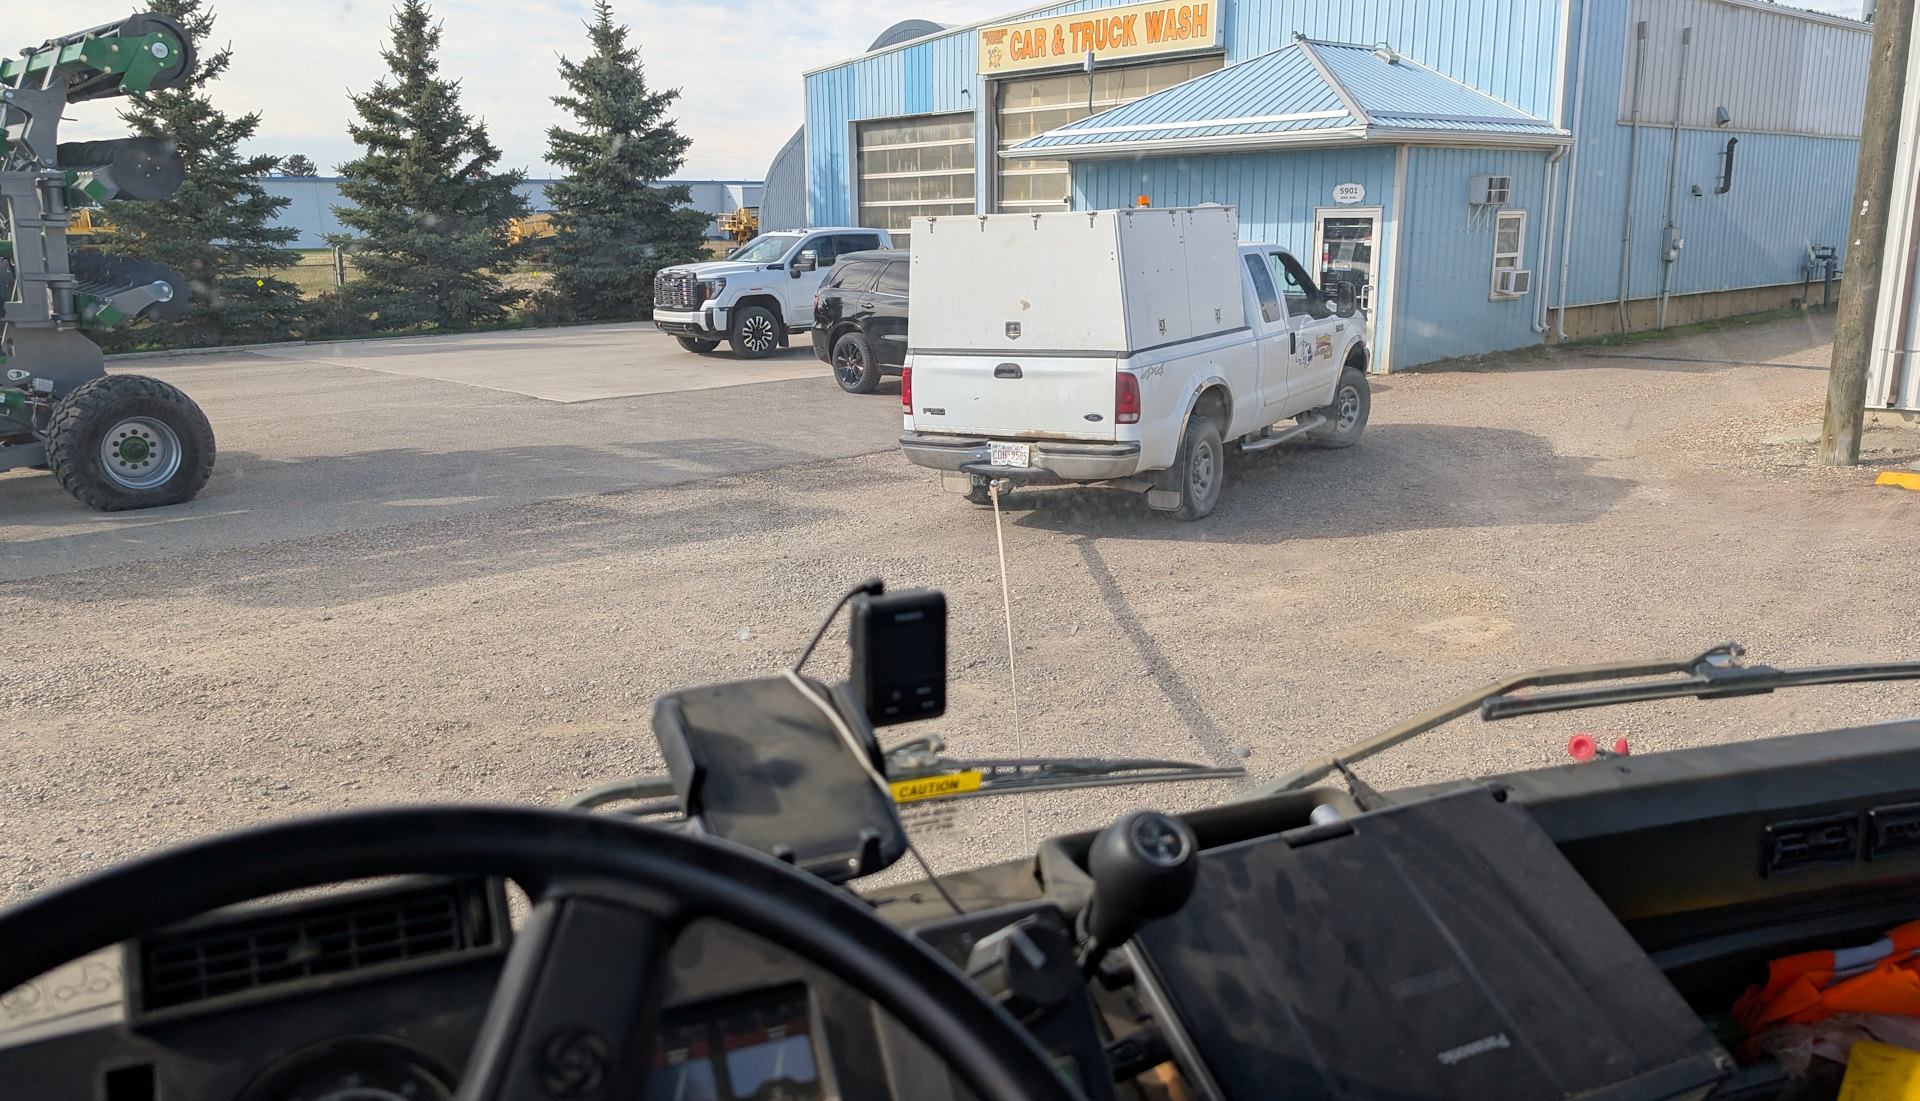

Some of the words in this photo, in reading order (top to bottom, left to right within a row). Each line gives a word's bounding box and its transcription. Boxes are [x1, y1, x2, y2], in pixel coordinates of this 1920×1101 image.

[1010, 28, 1047, 61] CAR
[1052, 24, 1065, 56] &
[1069, 14, 1137, 54] TRUCK
[1145, 4, 1208, 44] WASH
[899, 779, 959, 798] CAUTION
